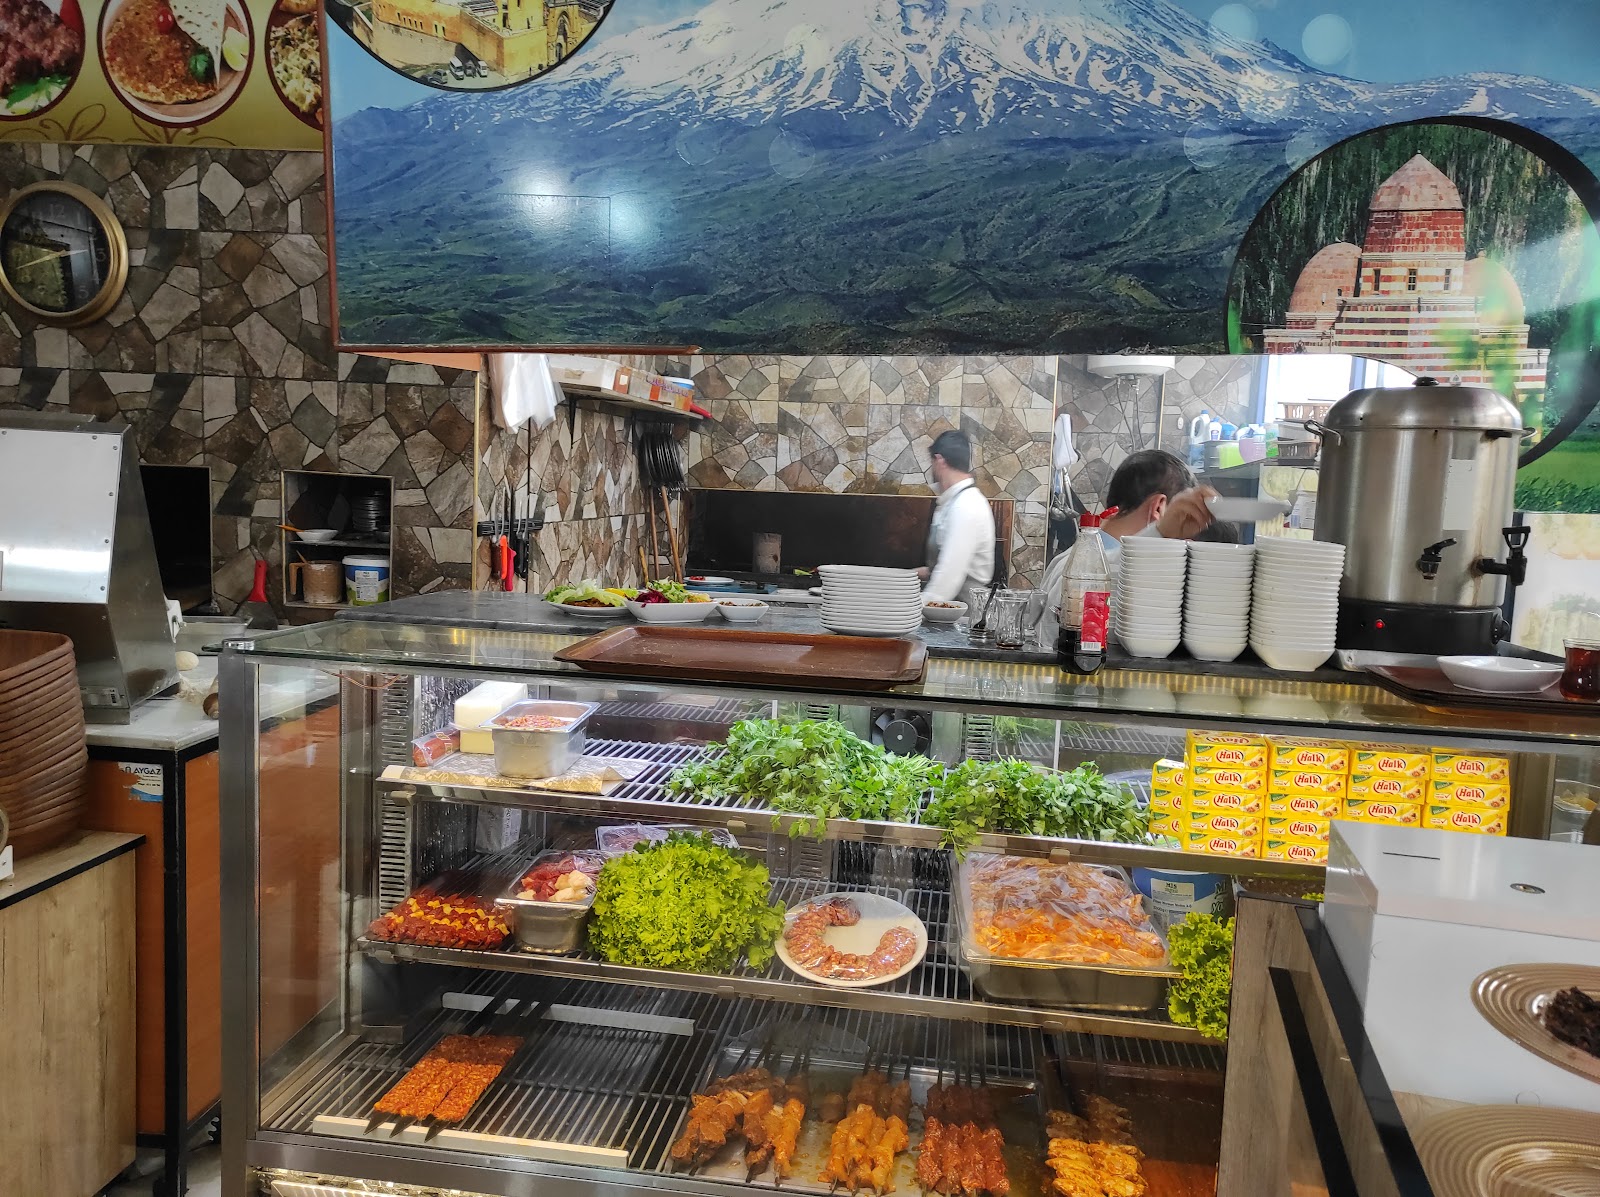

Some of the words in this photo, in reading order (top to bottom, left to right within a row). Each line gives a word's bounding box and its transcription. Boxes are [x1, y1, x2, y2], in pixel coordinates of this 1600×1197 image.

[1219, 750, 1241, 760] Halk
[1300, 752, 1322, 762] Halk
[1382, 759, 1404, 769] Halk
[1460, 761, 1482, 771] Halk
[134, 767, 162, 775] AYGAZ
[1217, 773, 1239, 783] Halk
[1297, 774, 1319, 784] Halk
[1376, 781, 1399, 791] Halk
[1459, 788, 1482, 798] Halk
[1216, 795, 1238, 805] Halk
[1293, 799, 1315, 809] Halk
[1371, 805, 1394, 815] Halk
[1214, 817, 1236, 827] Halk
[1455, 813, 1478, 824] Halk
[1292, 823, 1314, 833] Halk
[1212, 839, 1234, 849] Halk
[1291, 847, 1313, 857] Halk
